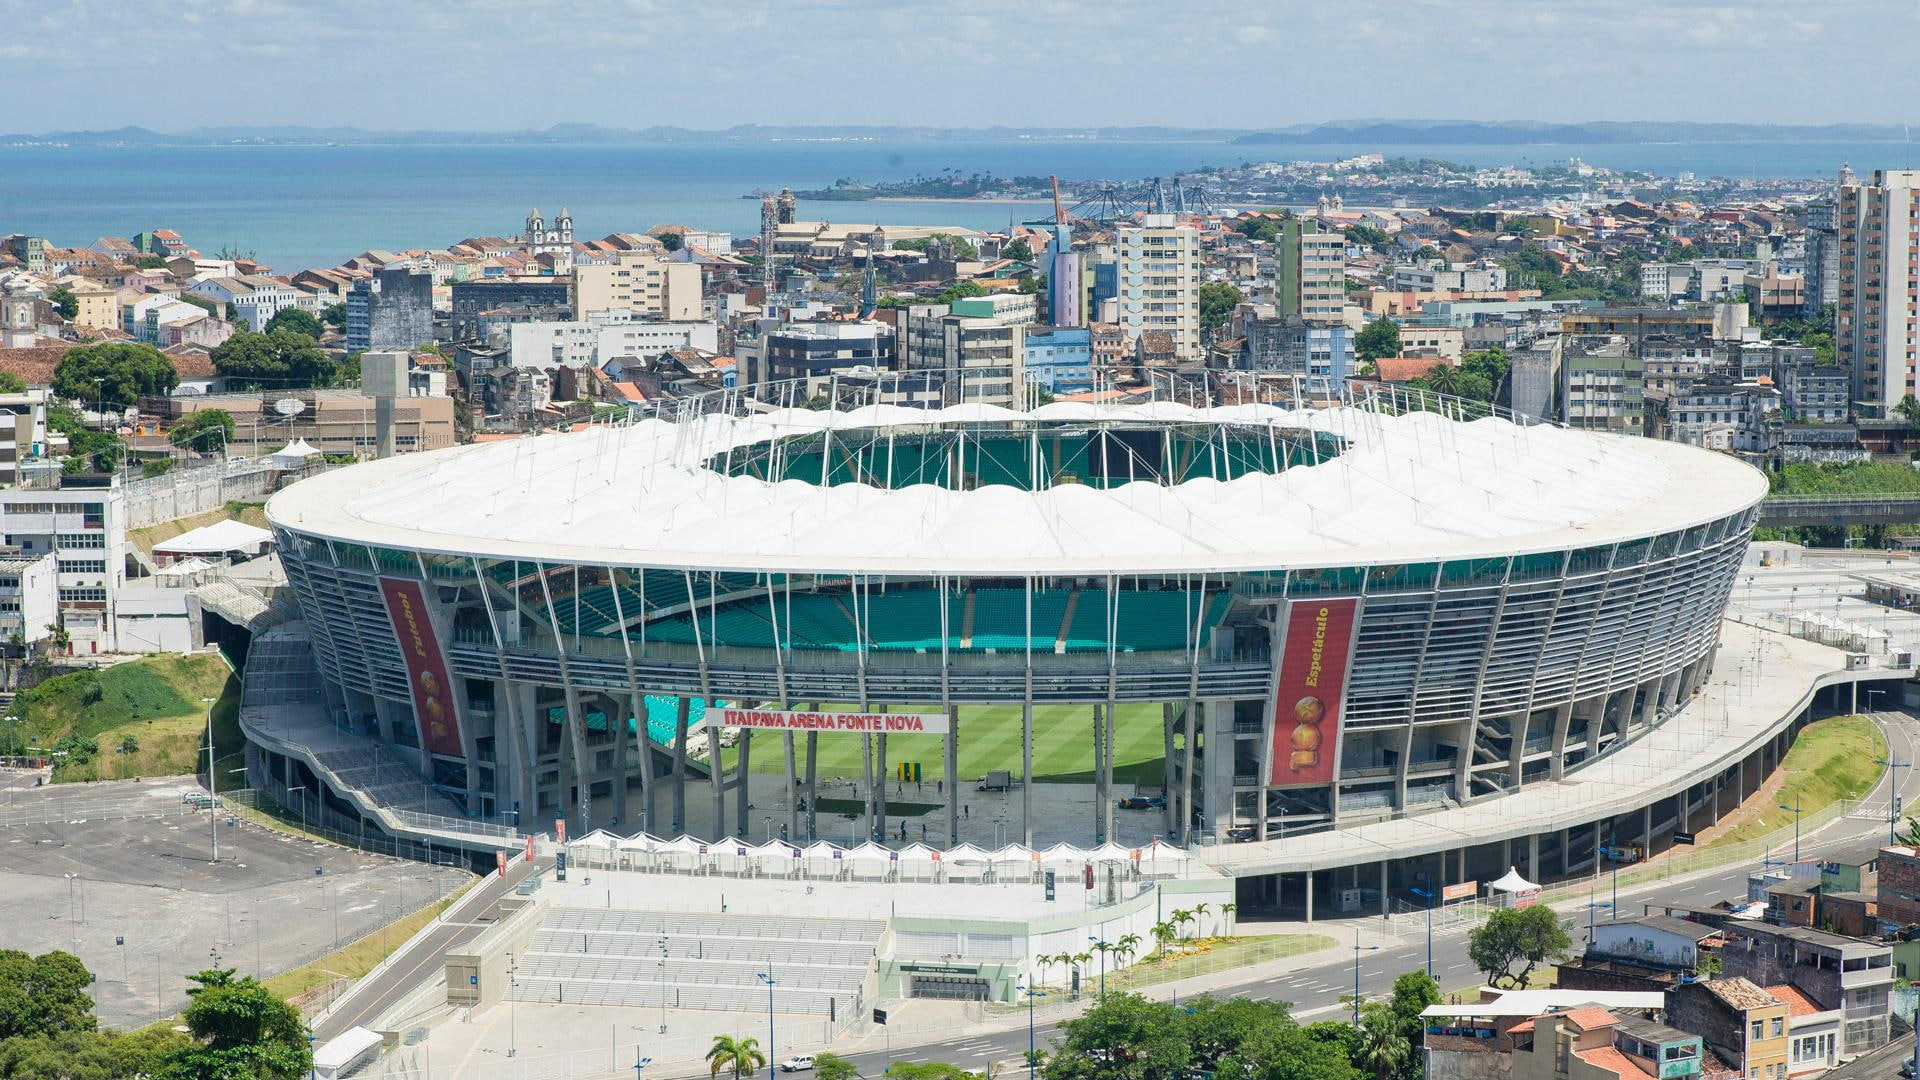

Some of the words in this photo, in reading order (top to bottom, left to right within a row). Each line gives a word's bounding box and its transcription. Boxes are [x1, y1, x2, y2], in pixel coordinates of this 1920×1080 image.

[398, 591, 426, 657] Futebol
[1305, 608, 1329, 687] Espetáculo
[724, 711, 785, 727] ITAIPAVA
[788, 713, 835, 729] ARENA
[837, 715, 882, 730] FONTE
[885, 716, 923, 730] NOVA
